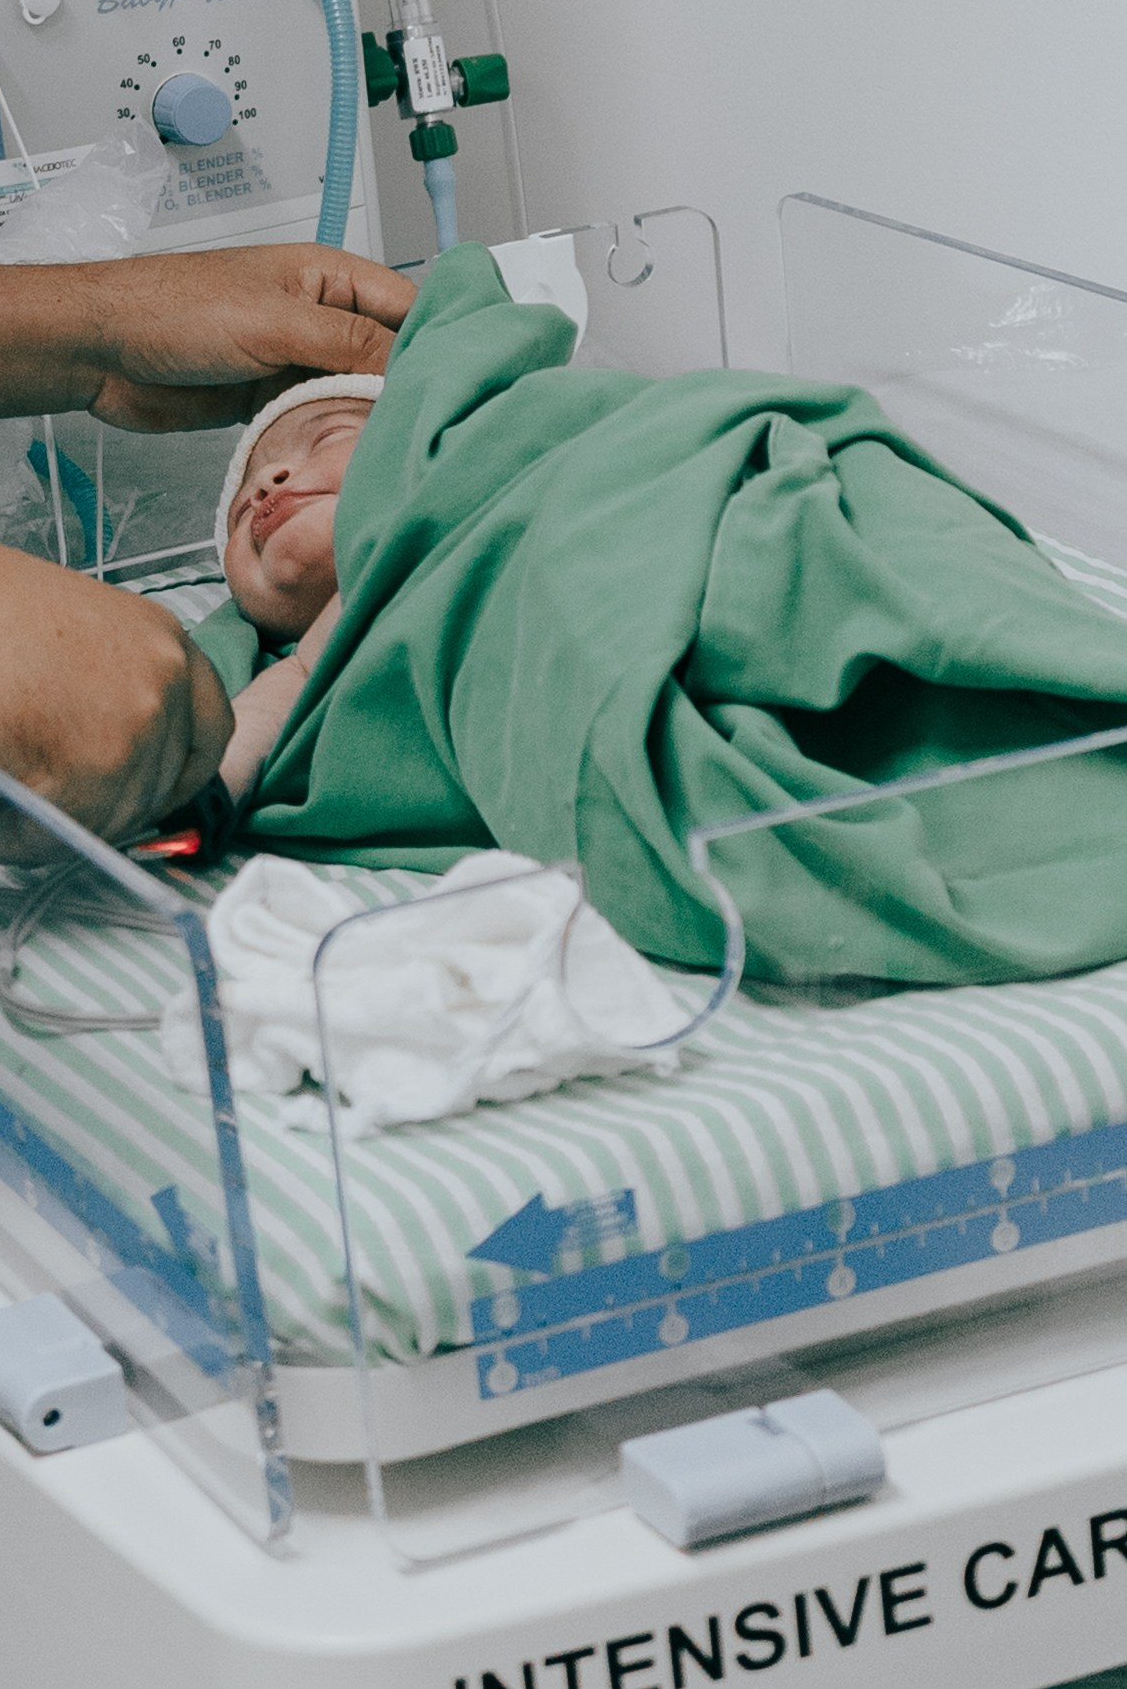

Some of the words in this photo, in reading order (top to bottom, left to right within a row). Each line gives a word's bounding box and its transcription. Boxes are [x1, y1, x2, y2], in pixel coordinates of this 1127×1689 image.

[172, 36, 186, 48] 60
[208, 39, 222, 51] 70
[137, 53, 151, 65] 50
[228, 55, 241, 67] 80
[119, 78, 134, 89] 40
[234, 80, 247, 92] 90
[117, 108, 130, 120] 30
[238, 108, 257, 120] 100
[179, 152, 244, 176] BLENDER
[252, 147, 264, 160] %
[179, 169, 244, 193] BLENDER
[251, 165, 264, 177] %
[188, 182, 253, 207] BLENDER
[259, 178, 272, 191] %
